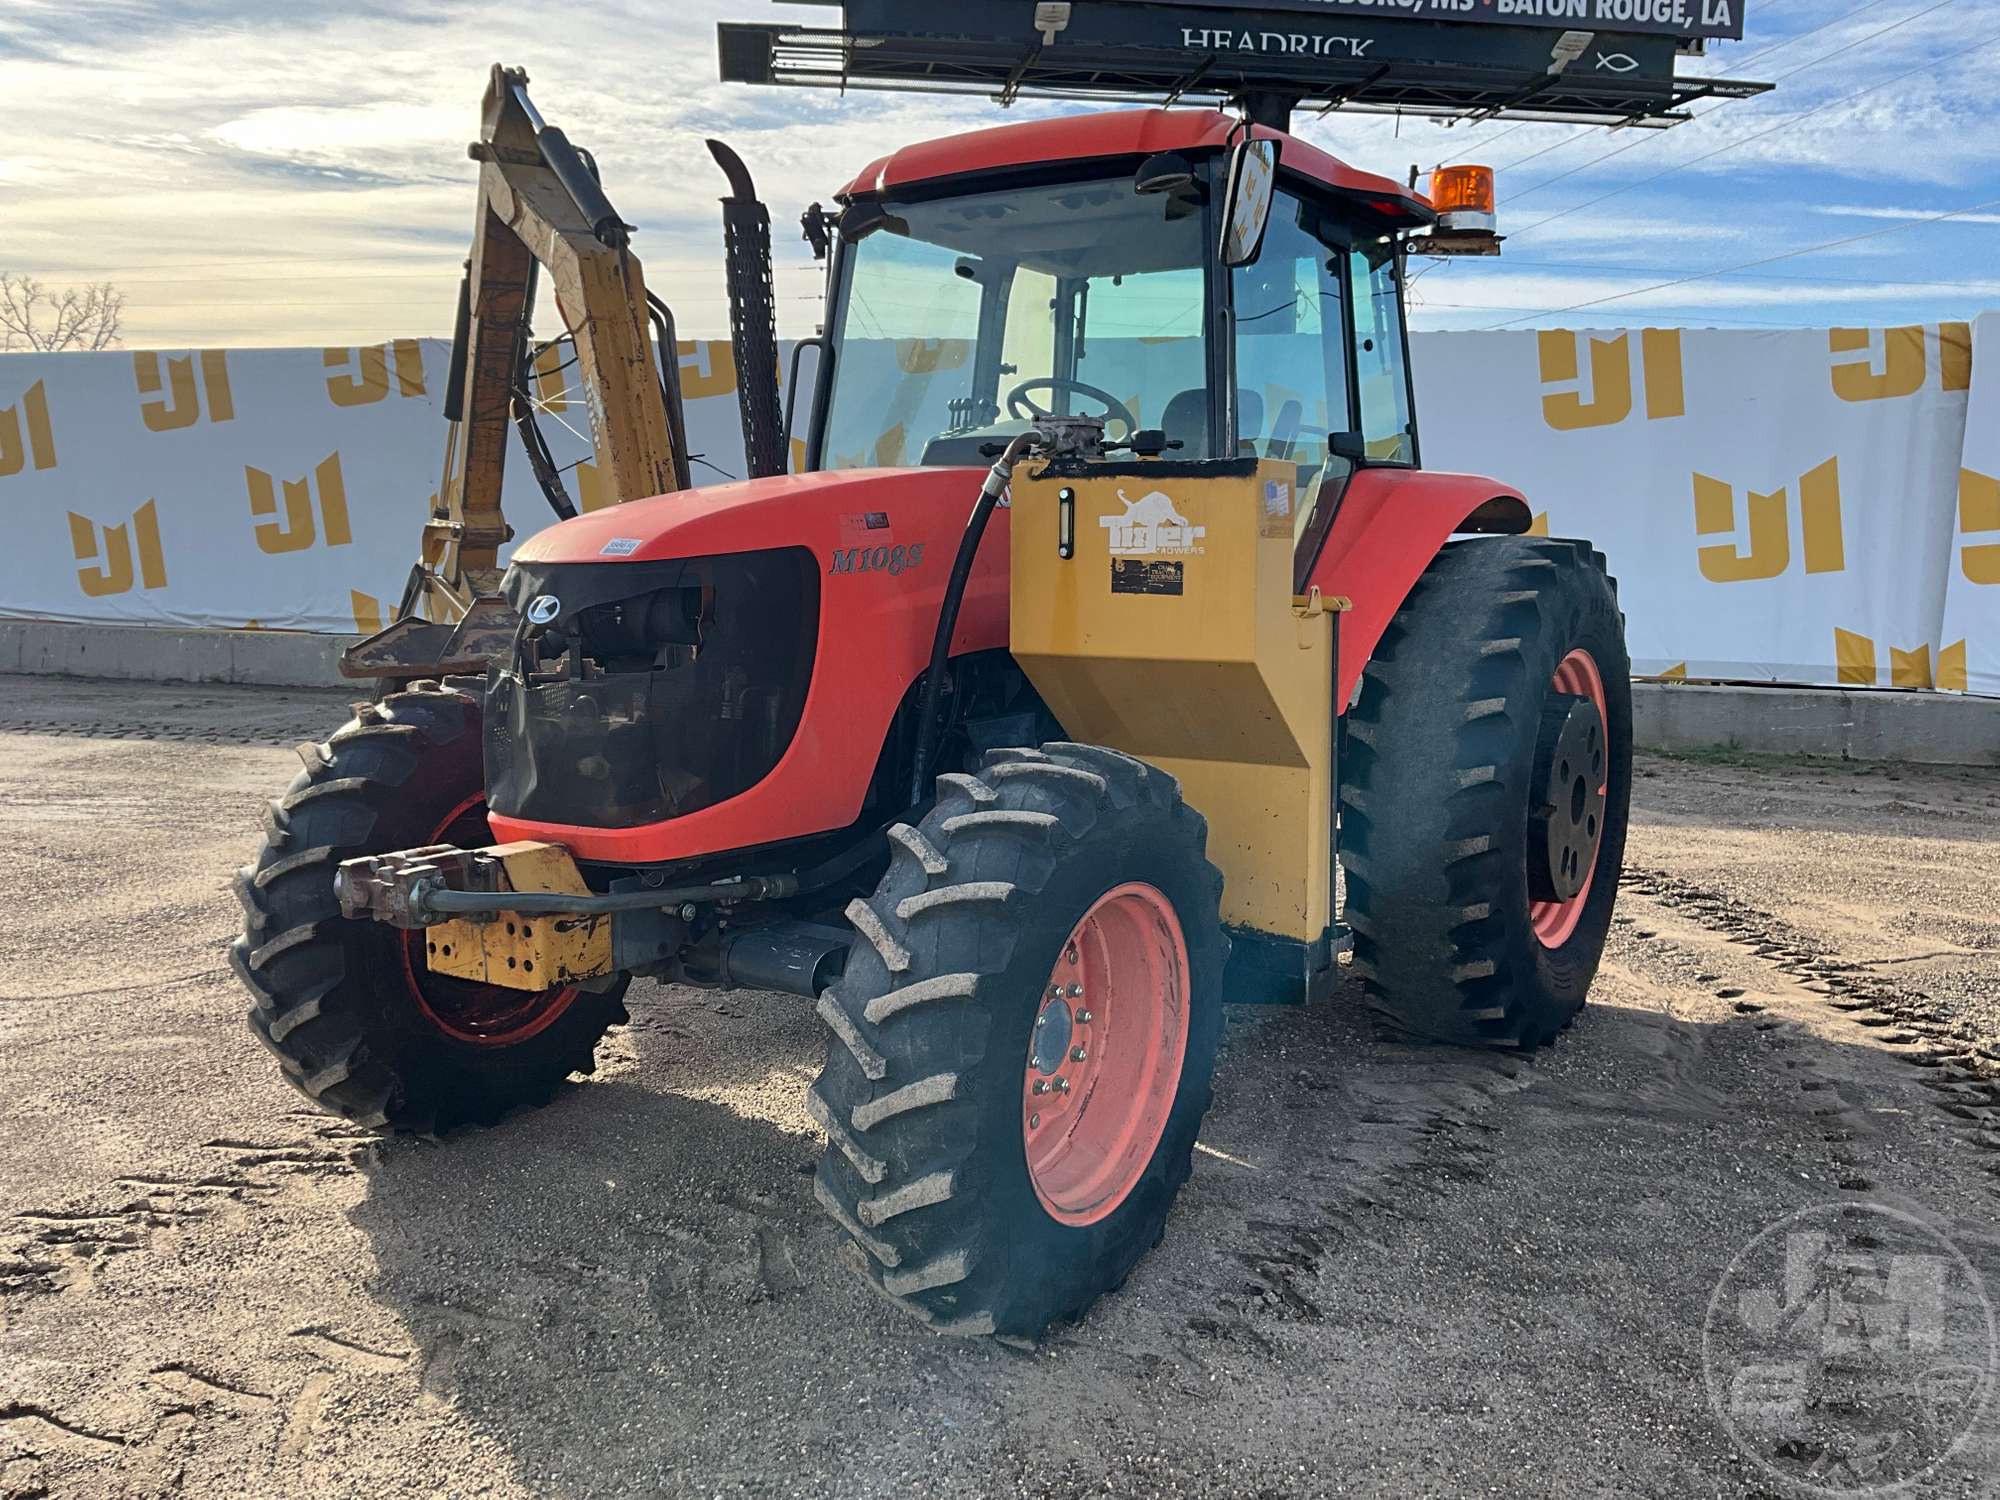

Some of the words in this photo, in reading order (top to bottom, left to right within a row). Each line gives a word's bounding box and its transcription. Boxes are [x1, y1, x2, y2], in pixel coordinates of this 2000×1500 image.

[1595, 0, 1693, 28] ROUGE,
[1701, 0, 1731, 26] LA
[1181, 28, 1374, 56] HEADRICK
[828, 543, 925, 576] M108S
